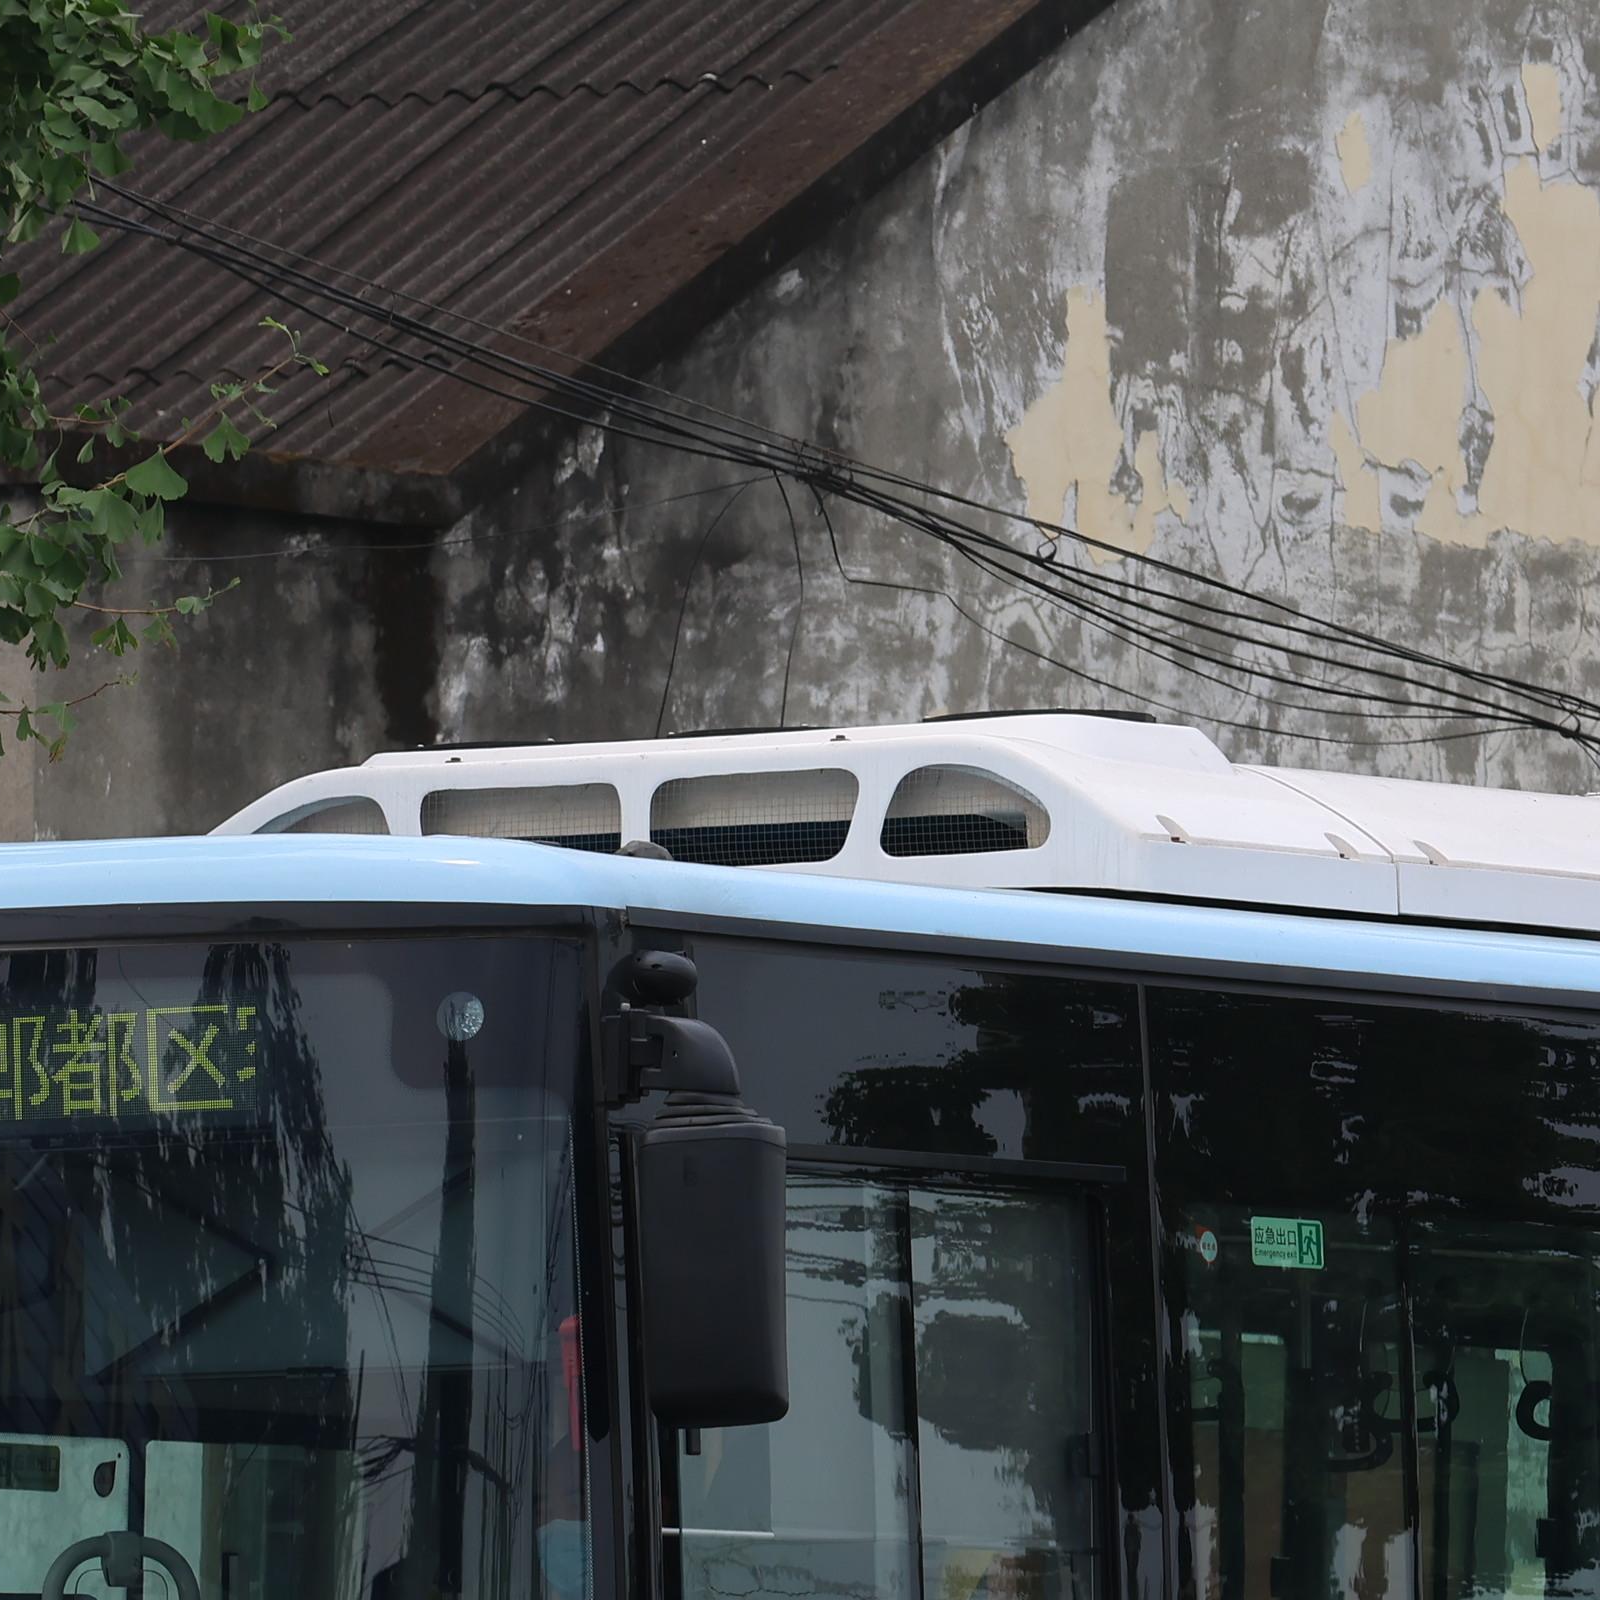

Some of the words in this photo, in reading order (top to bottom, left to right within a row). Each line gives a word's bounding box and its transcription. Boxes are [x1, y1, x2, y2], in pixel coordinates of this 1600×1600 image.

[1254, 1226, 1297, 1246] 应急出口
[1254, 1248, 1286, 1259] Emergency
